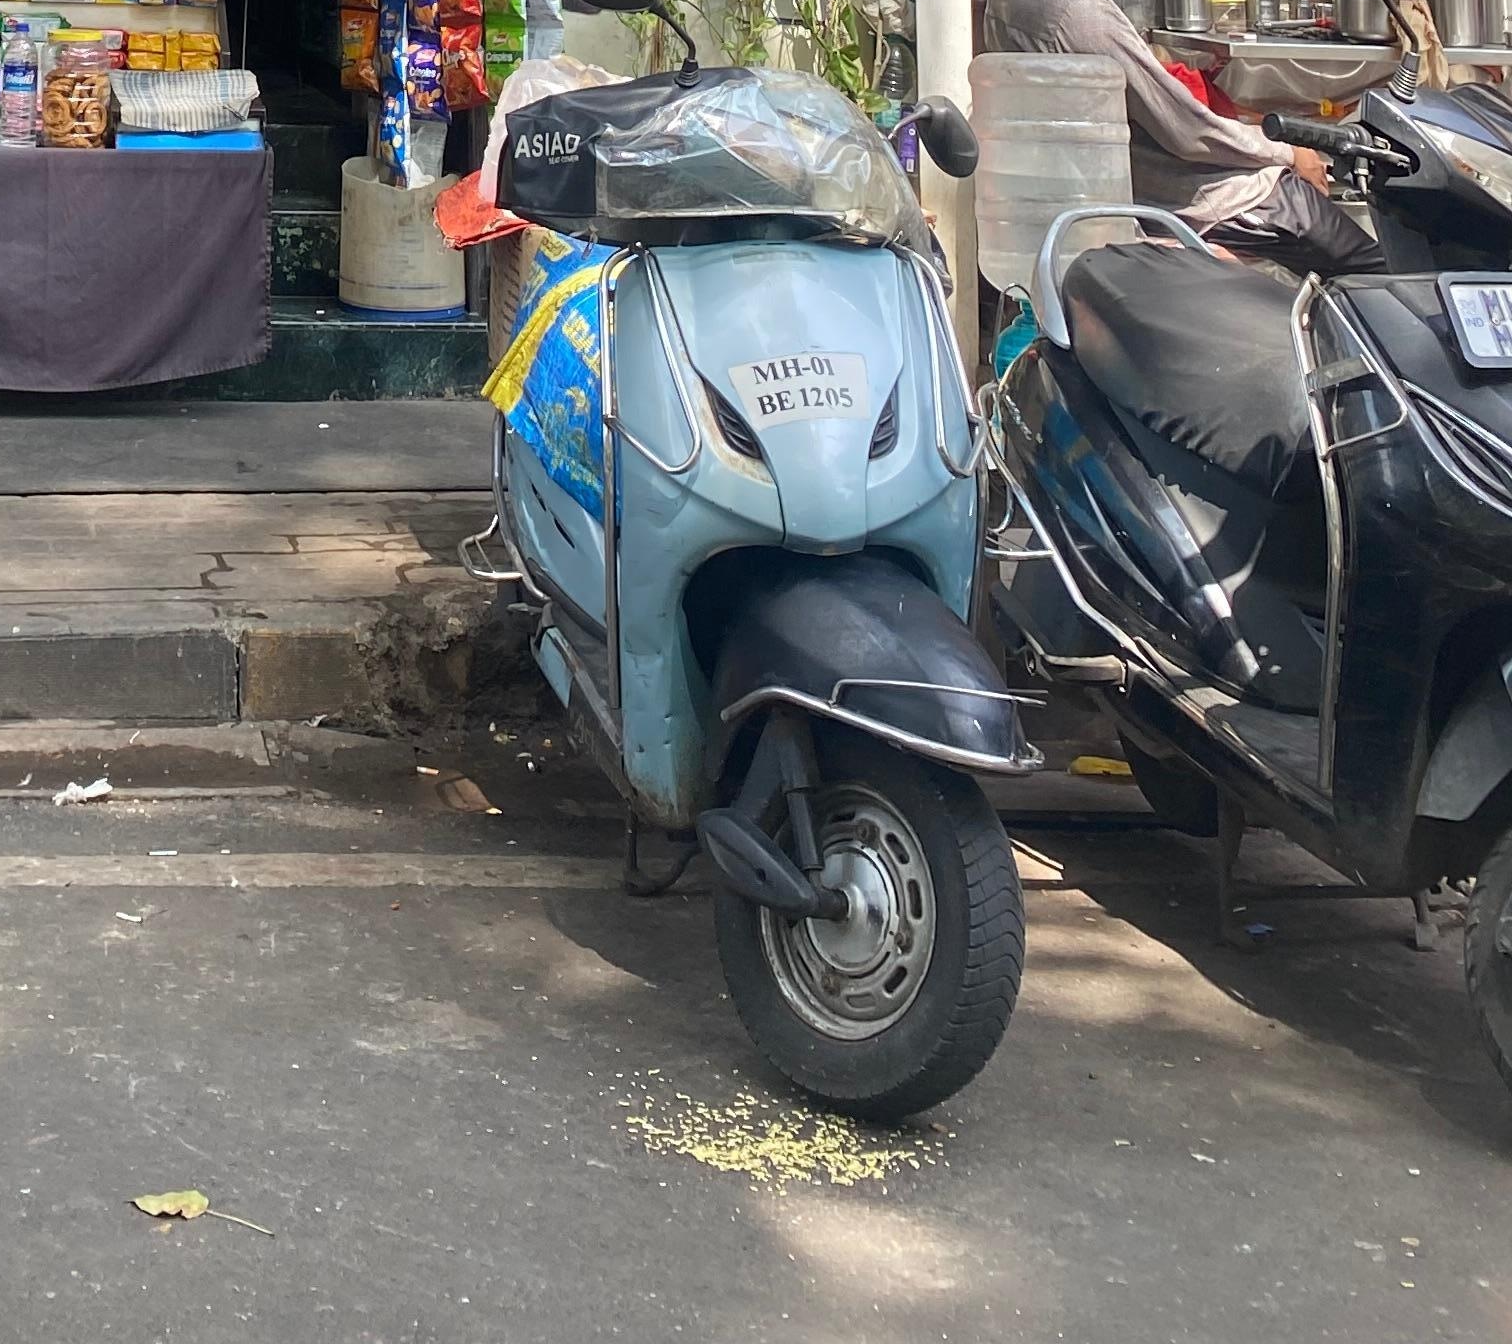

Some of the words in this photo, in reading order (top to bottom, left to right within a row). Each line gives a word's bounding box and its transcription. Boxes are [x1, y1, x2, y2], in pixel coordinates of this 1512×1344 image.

[752, 357, 834, 386] MH-01
[759, 392, 796, 415] BE
[801, 387, 853, 411] 1205
